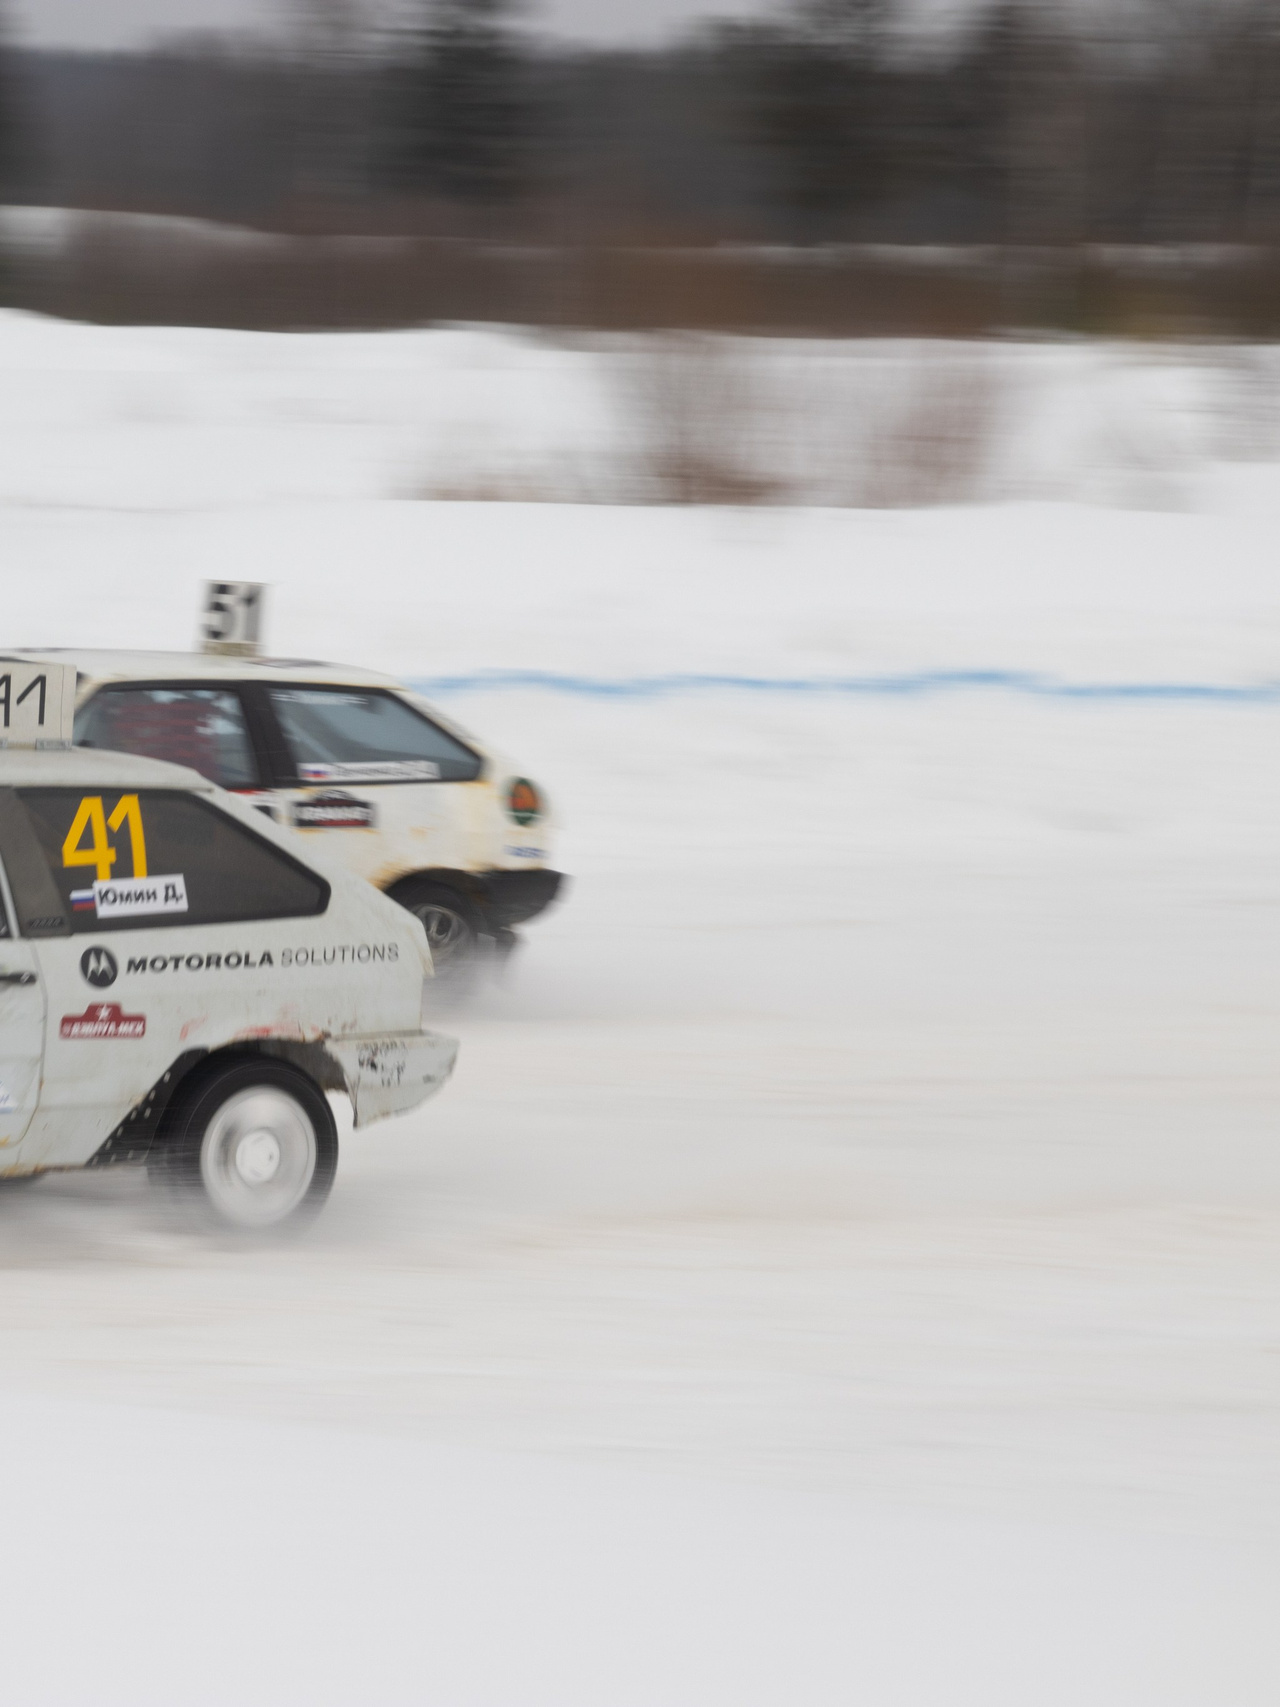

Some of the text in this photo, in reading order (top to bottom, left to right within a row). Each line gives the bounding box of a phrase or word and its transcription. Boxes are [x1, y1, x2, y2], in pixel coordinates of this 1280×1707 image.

[203, 582, 263, 639] 51
[62, 793, 147, 882] 41
[98, 882, 184, 906] Юмин Д.
[126, 942, 400, 974] MOTOROLA SOLUTIONS
